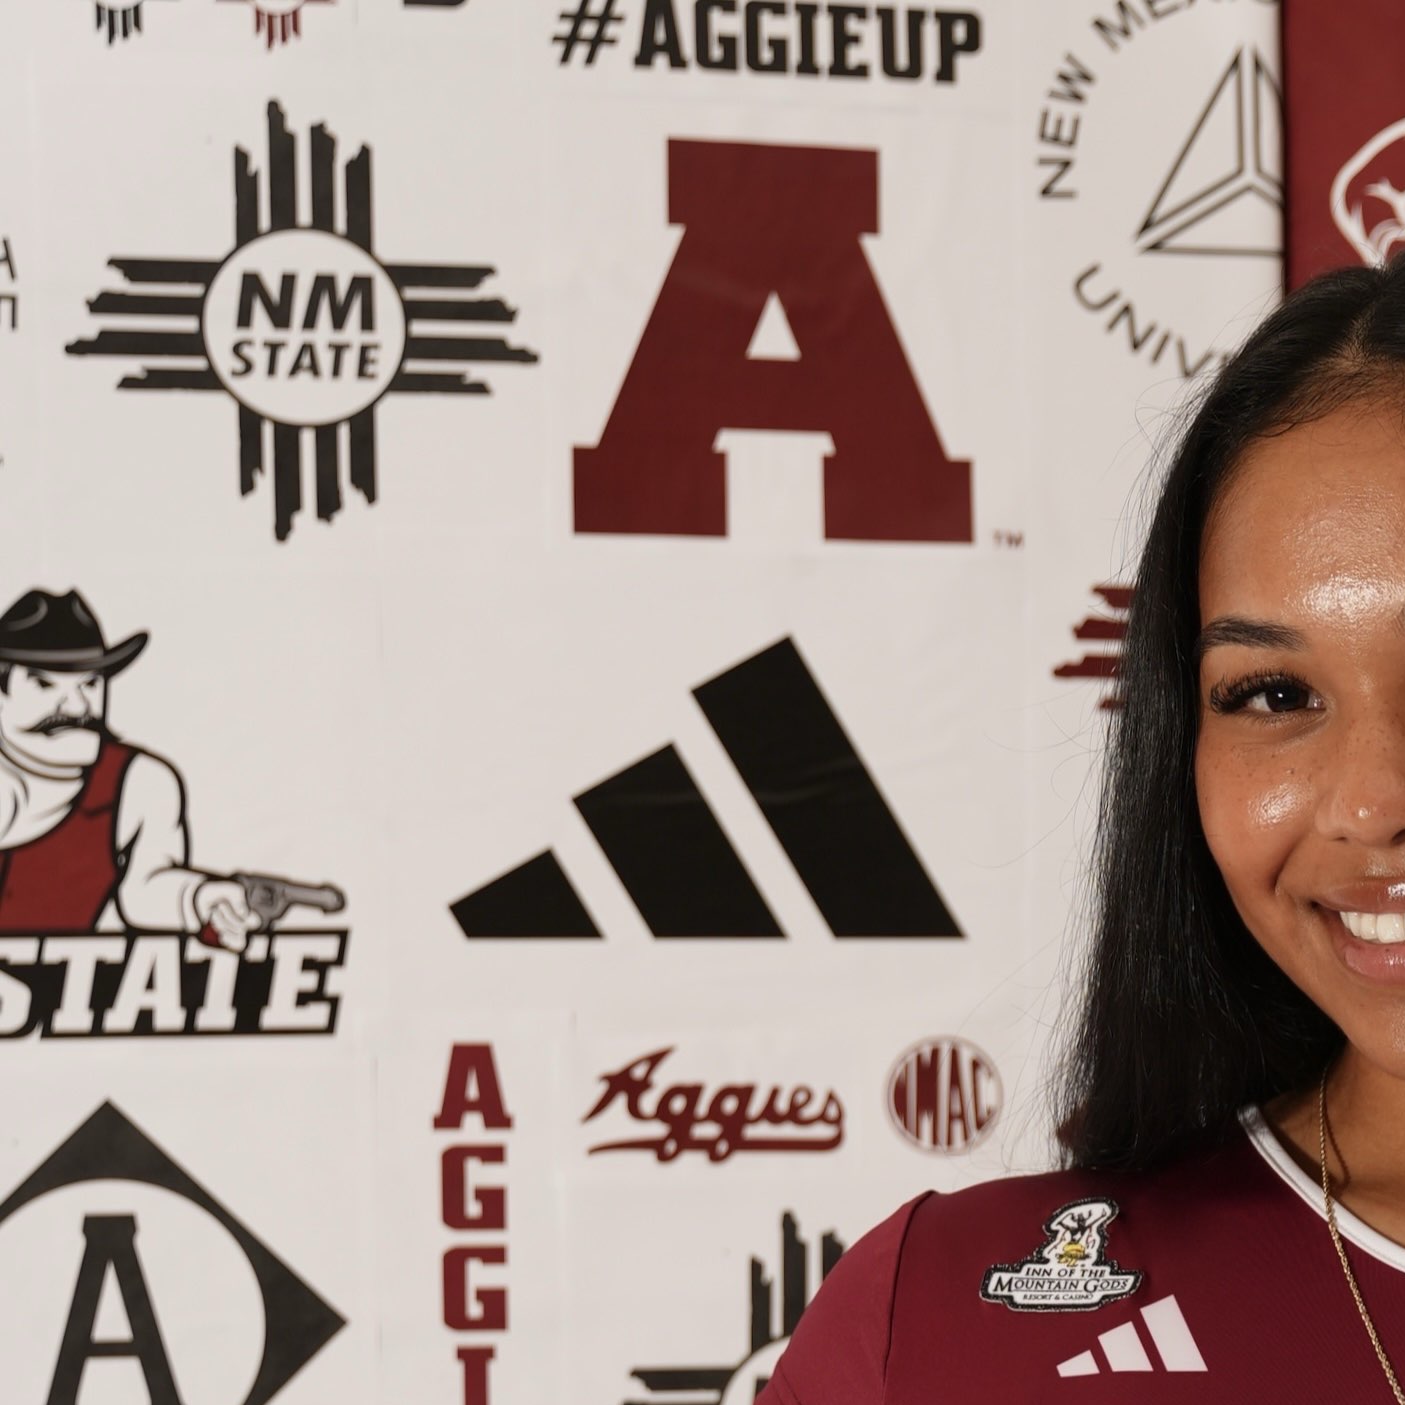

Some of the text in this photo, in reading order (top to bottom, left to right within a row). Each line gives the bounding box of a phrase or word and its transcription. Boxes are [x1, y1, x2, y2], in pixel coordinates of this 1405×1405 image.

[552, 0, 982, 85] #AGGIEUP
[1036, 53, 1095, 200] NEW
[235, 271, 378, 333] NM
[572, 135, 976, 545] A
[230, 339, 381, 381] STATE
[581, 1045, 846, 1165] Aggies
[1025, 1267, 1106, 1278] INN OF THE
